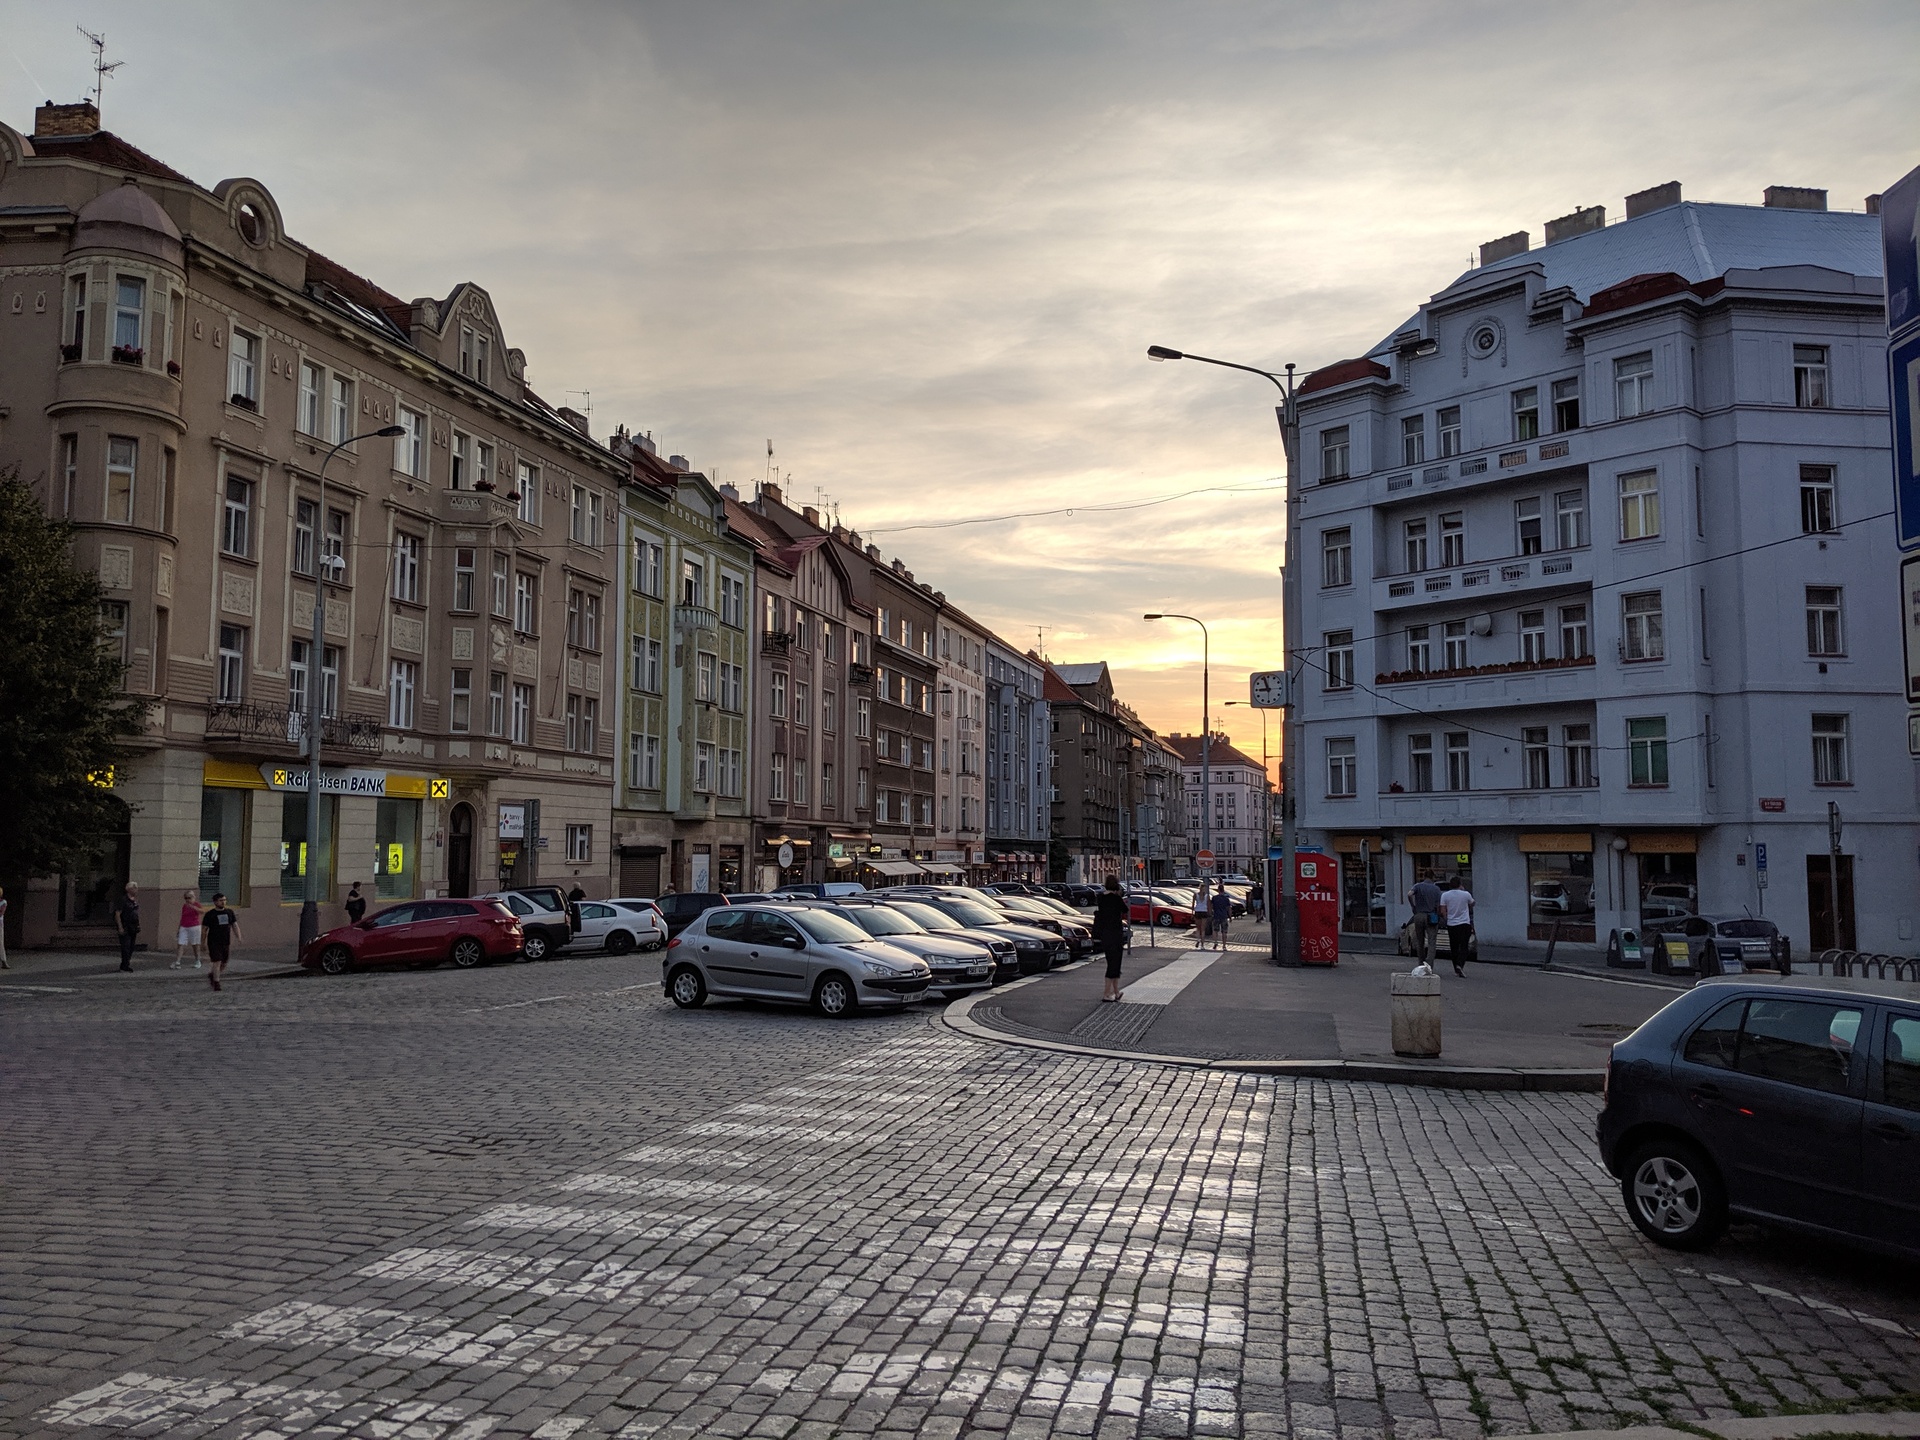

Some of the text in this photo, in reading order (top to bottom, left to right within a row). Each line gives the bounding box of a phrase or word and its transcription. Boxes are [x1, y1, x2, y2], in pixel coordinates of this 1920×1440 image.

[286, 770, 385, 793] Raifeisen BANK
[391, 853, 400, 870] 3
[1758, 846, 1765, 861] P
